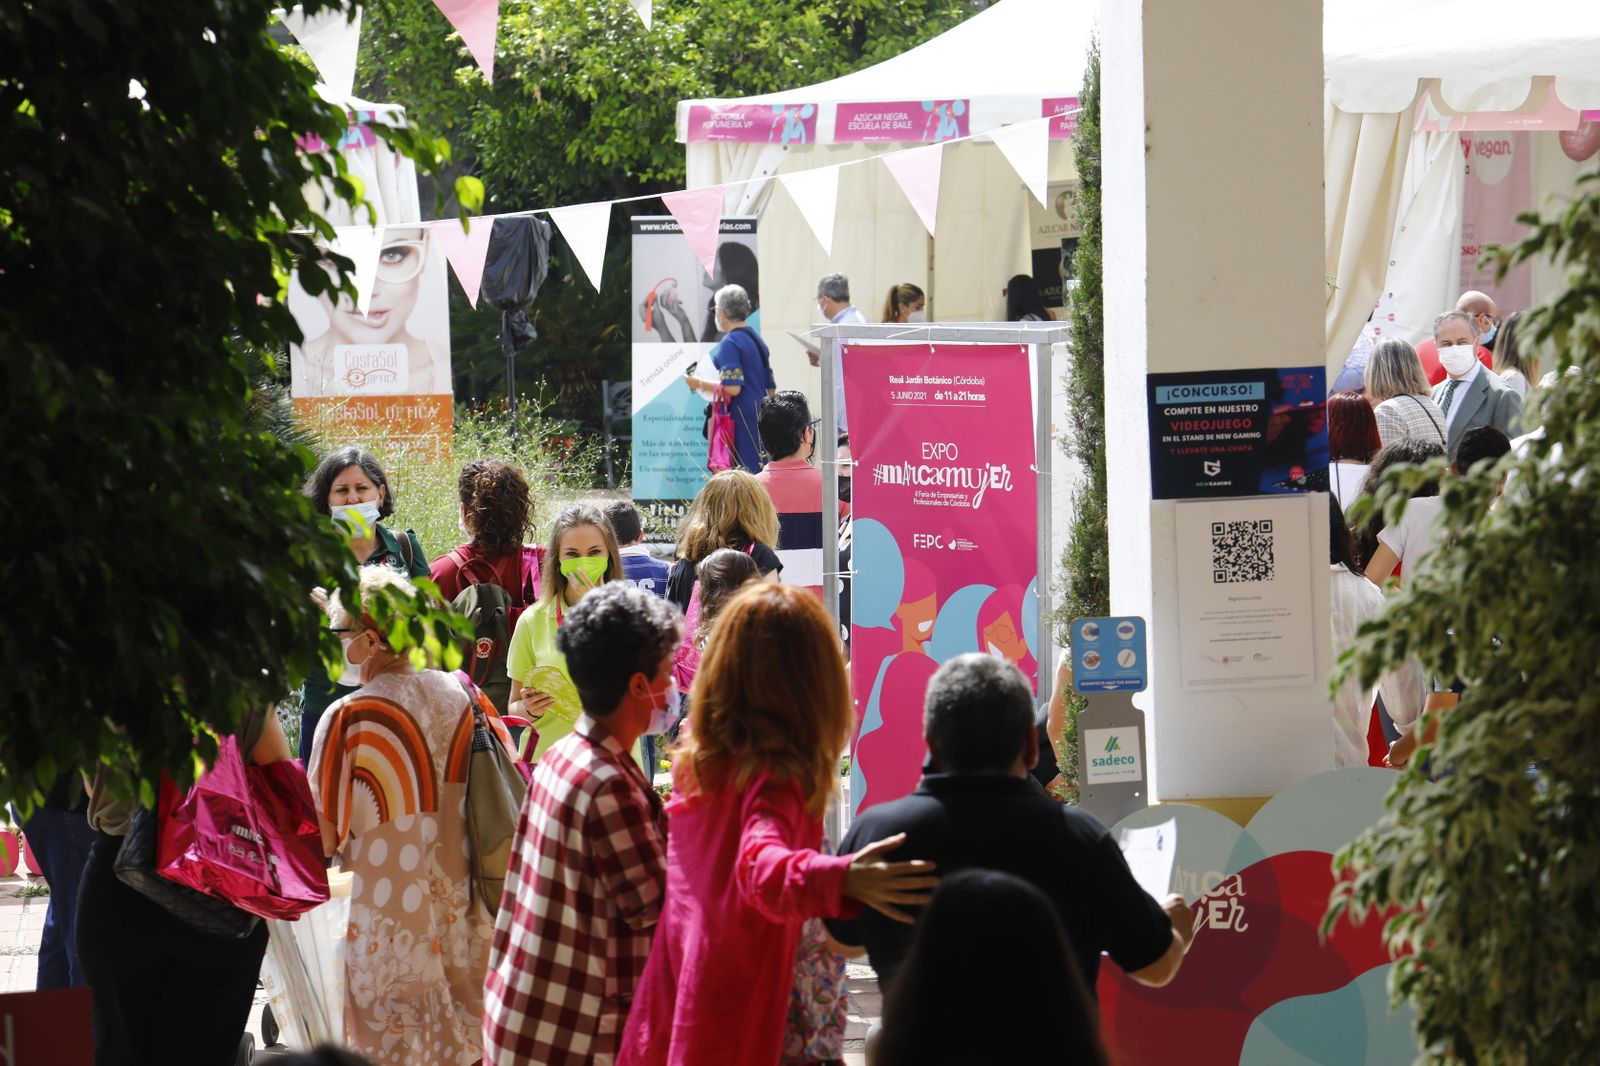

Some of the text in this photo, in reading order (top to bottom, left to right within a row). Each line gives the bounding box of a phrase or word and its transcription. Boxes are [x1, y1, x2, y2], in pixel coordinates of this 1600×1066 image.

[883, 112, 909, 121] NEGRA
[848, 120, 912, 130] ESCUELA DE BAILE
[1474, 140, 1511, 159] vegan
[344, 350, 398, 369] CostaSol
[640, 347, 685, 388] Tienda online
[889, 375, 904, 384] Real
[924, 375, 952, 384] Botánico
[953, 376, 986, 386] (Córdoba)
[891, 391, 896, 400] 5
[896, 391, 914, 400] JUNIO
[914, 391, 928, 400] 2021
[934, 390, 944, 400] de
[944, 391, 952, 400] 11
[958, 391, 967, 400] 21
[967, 391, 986, 401] horas
[1167, 384, 1252, 401] ¡CONCURSO!
[1164, 404, 1259, 416] COMPITE EN NUESTRO
[1170, 418, 1252, 432] VIDEOJUEGO
[1182, 434, 1204, 442] STAND
[921, 442, 958, 461] EXPO
[1227, 444, 1253, 452] CHAPA
[943, 498, 950, 506] de
[950, 499, 971, 507] Córdoba
[913, 534, 944, 549] FEPC
[1091, 754, 1135, 768] sadeco
